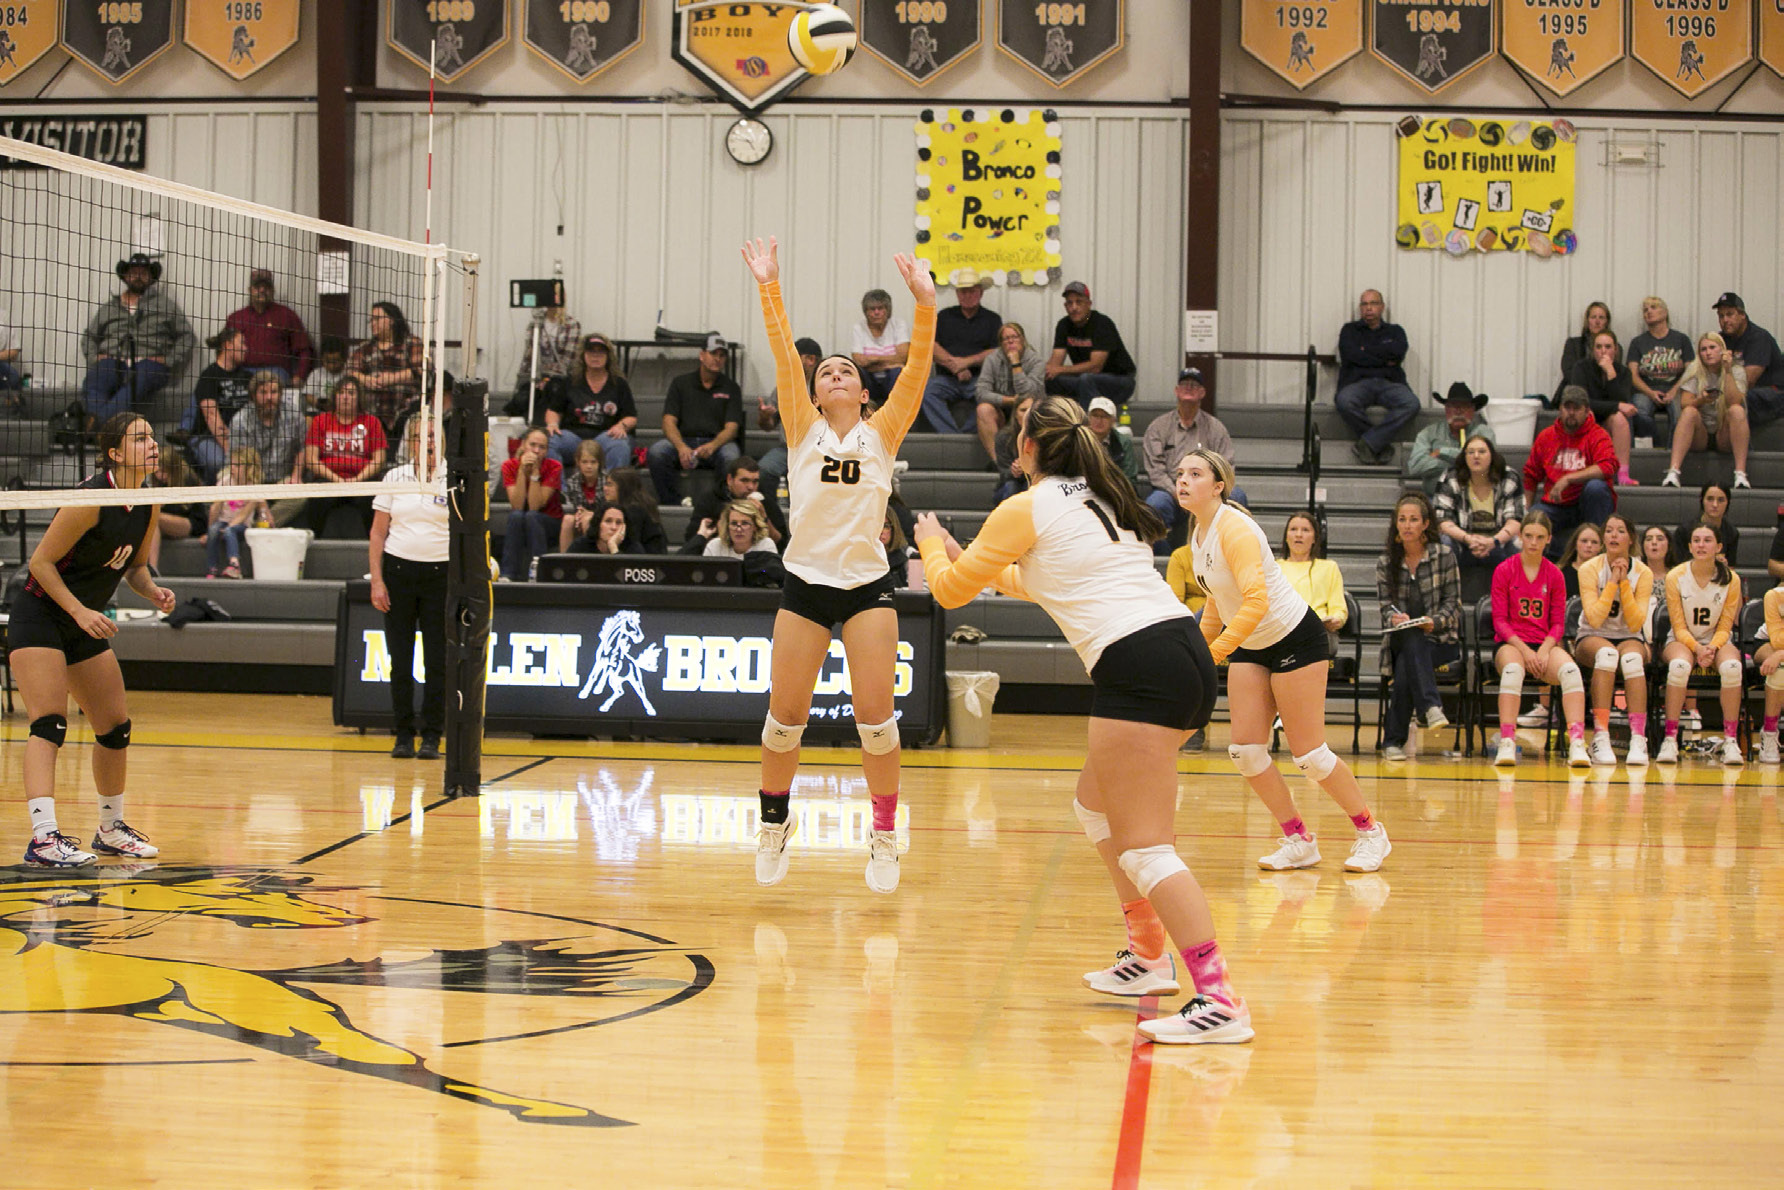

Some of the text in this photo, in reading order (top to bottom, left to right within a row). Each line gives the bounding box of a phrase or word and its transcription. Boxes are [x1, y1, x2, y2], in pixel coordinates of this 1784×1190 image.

[98, 2, 143, 24] 1985
[225, 2, 263, 21] 1986
[560, 1, 610, 23] 1990
[895, 2, 947, 24] 1990
[1035, 3, 1086, 26] 1991
[1275, 7, 1328, 29] 1992
[1406, 9, 1461, 33] 1994
[694, 26, 753, 37] 2017 2018
[1538, 14, 1588, 36] 1995
[1665, 15, 1716, 37] 1996
[3, 120, 142, 163] VISITOR
[962, 150, 1035, 181] Bronco
[1424, 150, 1556, 174] Go! Fight! Win!
[821, 455, 860, 485] 20
[103, 544, 133, 570] 10
[624, 568, 656, 583] POSS
[1519, 598, 1544, 618] 33
[1693, 607, 1711, 626] 12
[361, 630, 914, 697] MLEN BROCS
